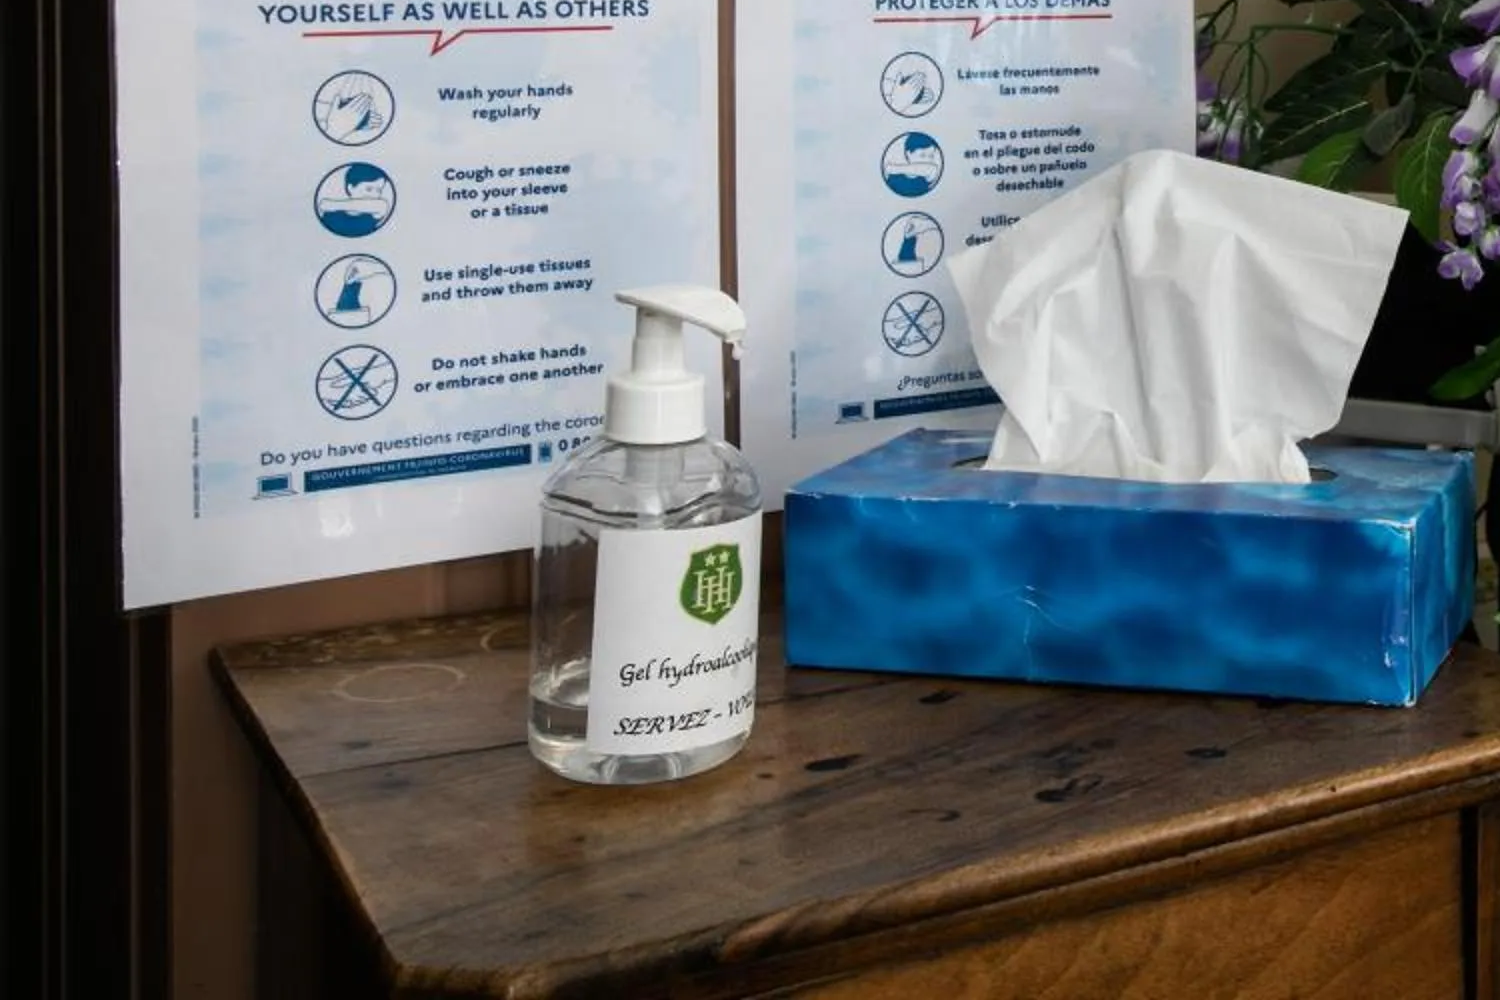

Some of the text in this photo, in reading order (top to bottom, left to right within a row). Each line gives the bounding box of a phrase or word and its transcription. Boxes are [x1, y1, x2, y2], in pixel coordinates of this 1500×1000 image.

[258, 2, 395, 25] YOURSELF
[402, 1, 435, 22] AS
[443, 0, 509, 21] WELL
[516, 0, 548, 20] AS
[957, 65, 1100, 81] Lávese frecuentemente
[438, 82, 574, 103] Wash your hands
[1000, 84, 1060, 96] las manos
[472, 104, 542, 122] regularly
[979, 125, 1082, 141] Tosa o estornude
[963, 141, 1096, 159] en el pliegue del codo
[443, 164, 571, 183] Cough or sneeze
[972, 159, 1088, 176] o sobre un pañuelo
[447, 182, 568, 202] into your sleeve
[995, 176, 1065, 193] desechable
[470, 203, 549, 219] or a tissue
[423, 257, 592, 283] Use single-use tissues
[421, 277, 594, 303] and throw them away
[432, 344, 588, 371] Do not shake hands
[414, 362, 605, 394] or embrace one another
[260, 418, 561, 467] Do you have questions regarding the
[619, 659, 657, 688] Gel
[613, 707, 711, 736] SERVEZ
